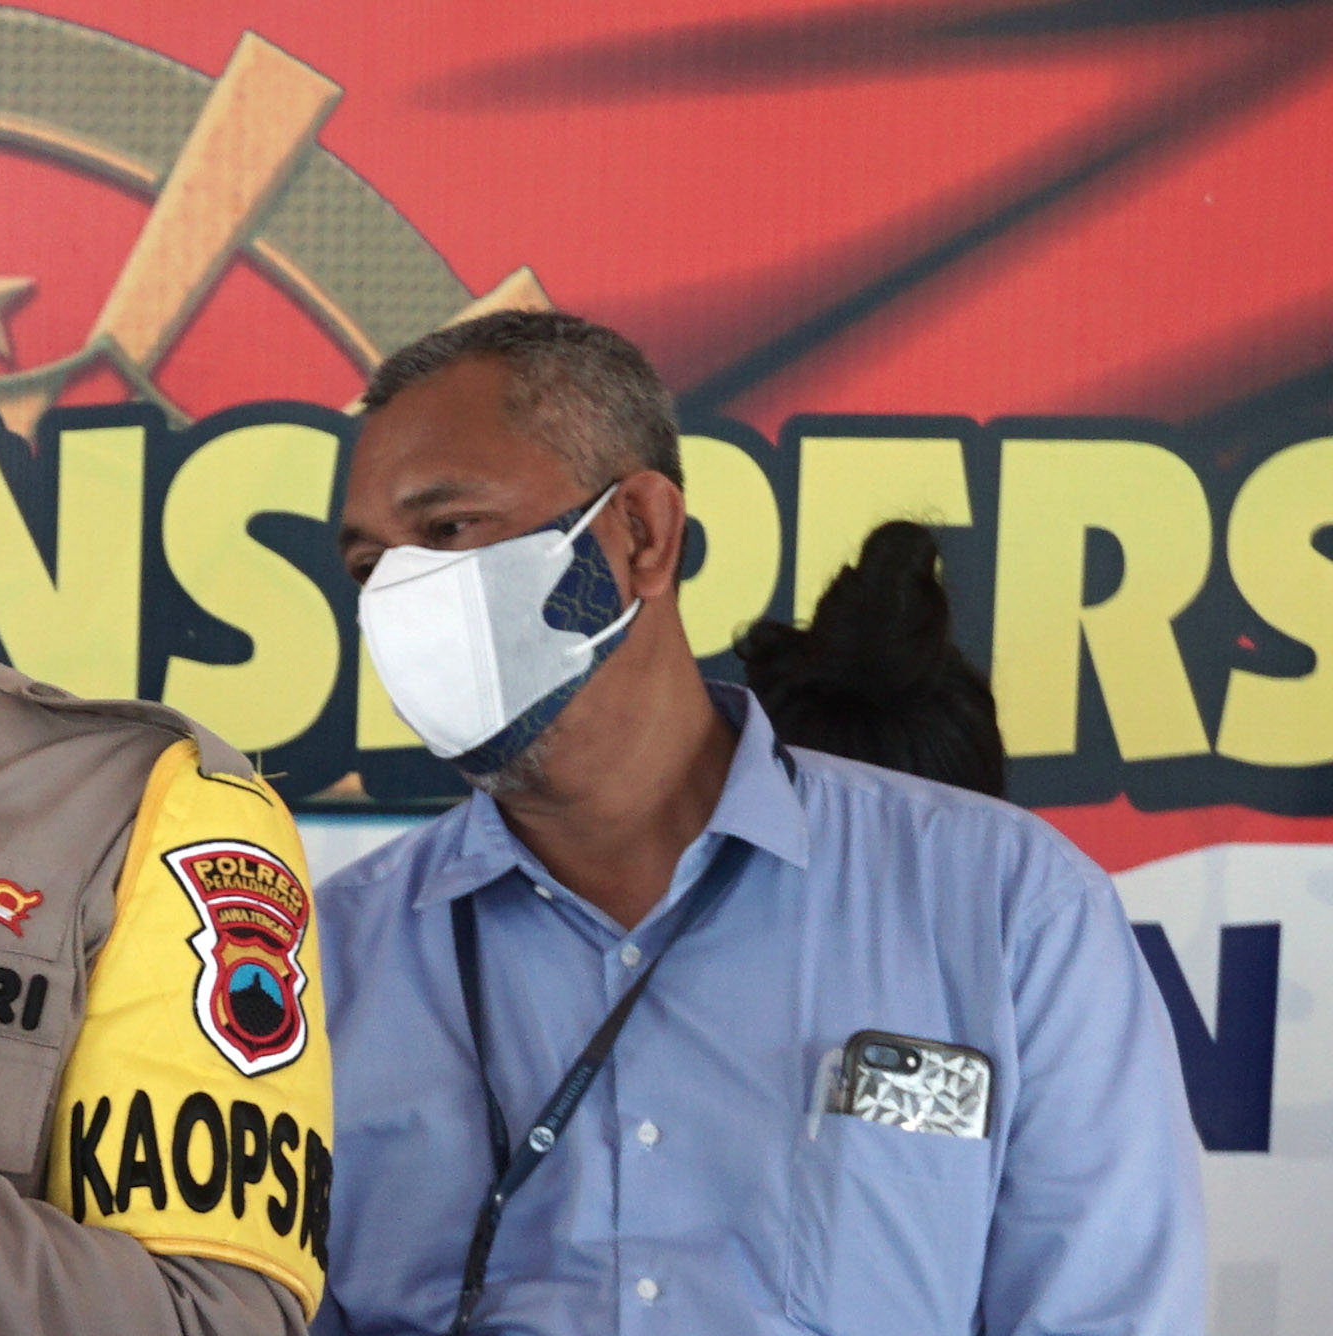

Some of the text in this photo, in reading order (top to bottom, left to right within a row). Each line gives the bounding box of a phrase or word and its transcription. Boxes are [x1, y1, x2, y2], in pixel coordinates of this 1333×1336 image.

[193, 856, 303, 911] POLRES
[204, 874, 301, 917] PEKALONGAN
[218, 907, 249, 924] JAWA
